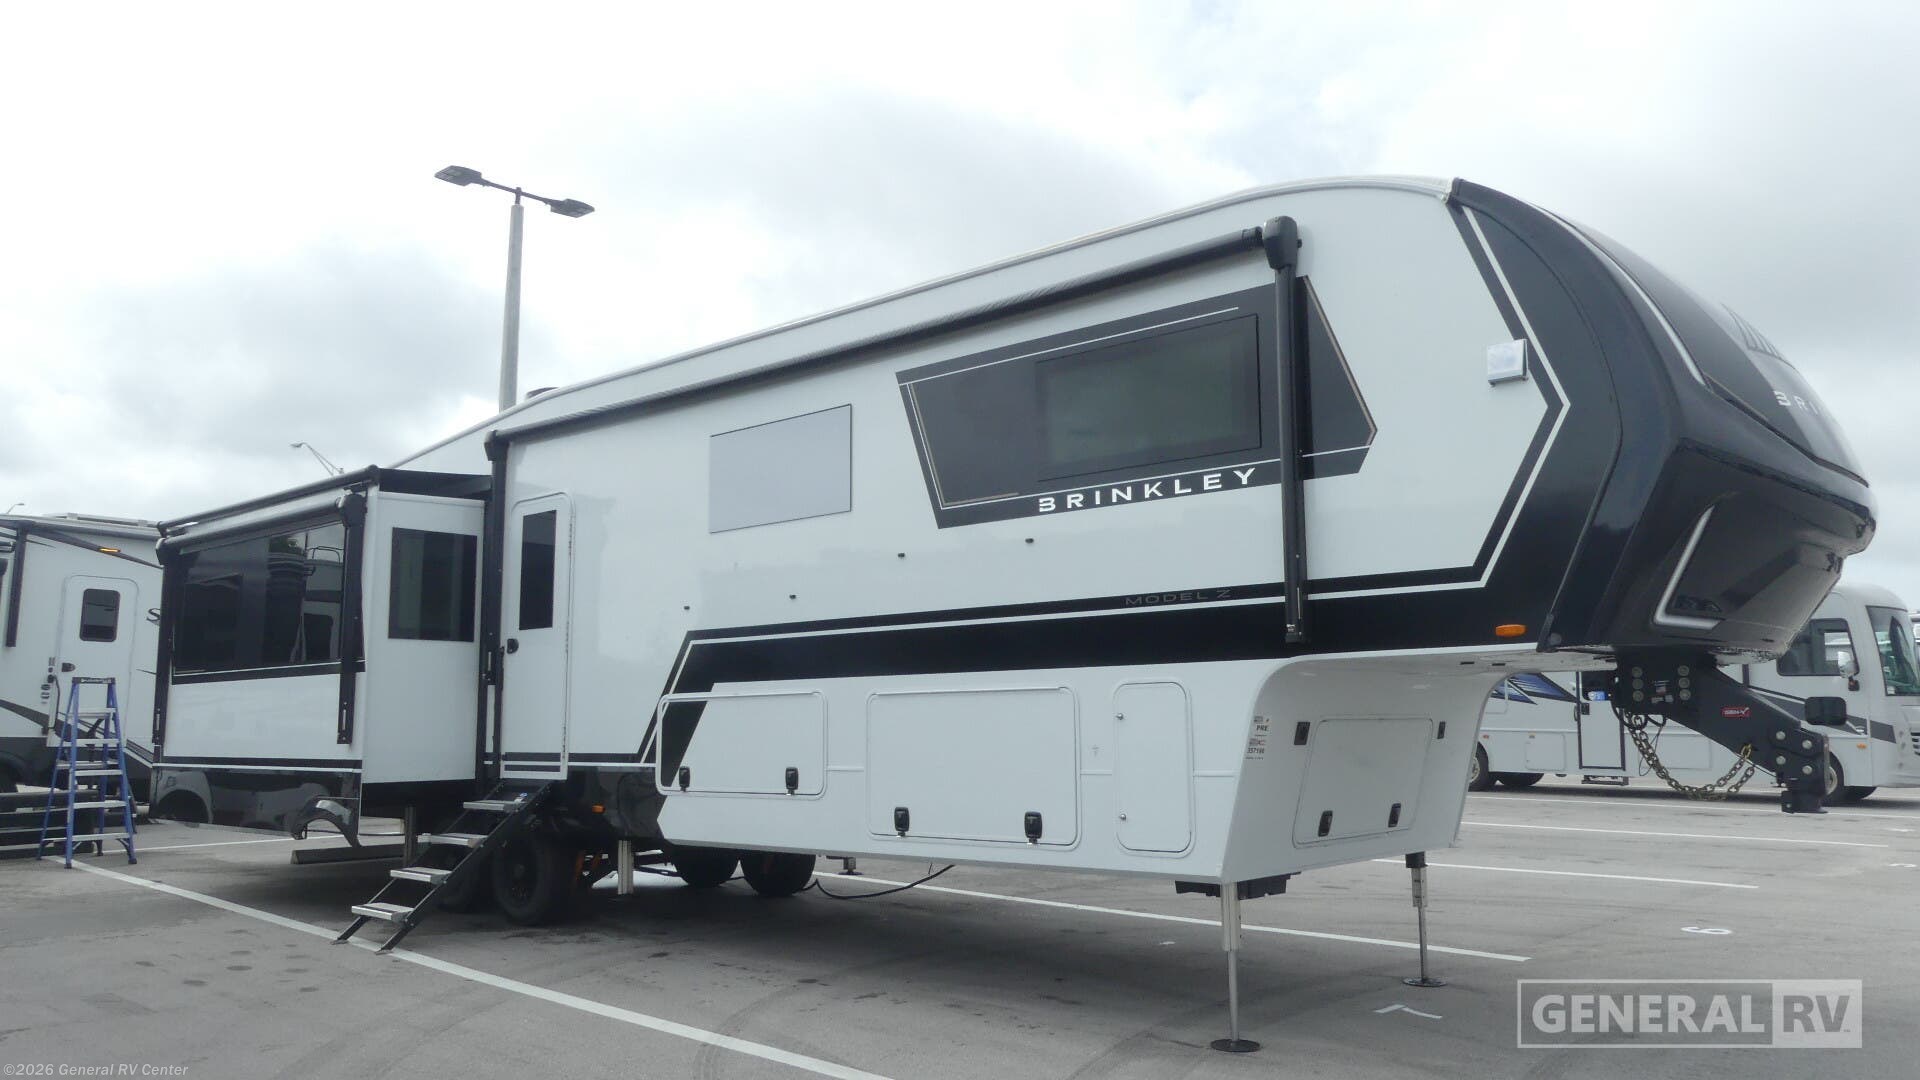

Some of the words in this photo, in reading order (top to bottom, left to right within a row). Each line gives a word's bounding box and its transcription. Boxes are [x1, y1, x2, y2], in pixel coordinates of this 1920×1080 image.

[1038, 467, 1256, 513] BRINKLEY
[1125, 591, 1209, 606] MODEL
[1216, 589, 1231, 599] Z
